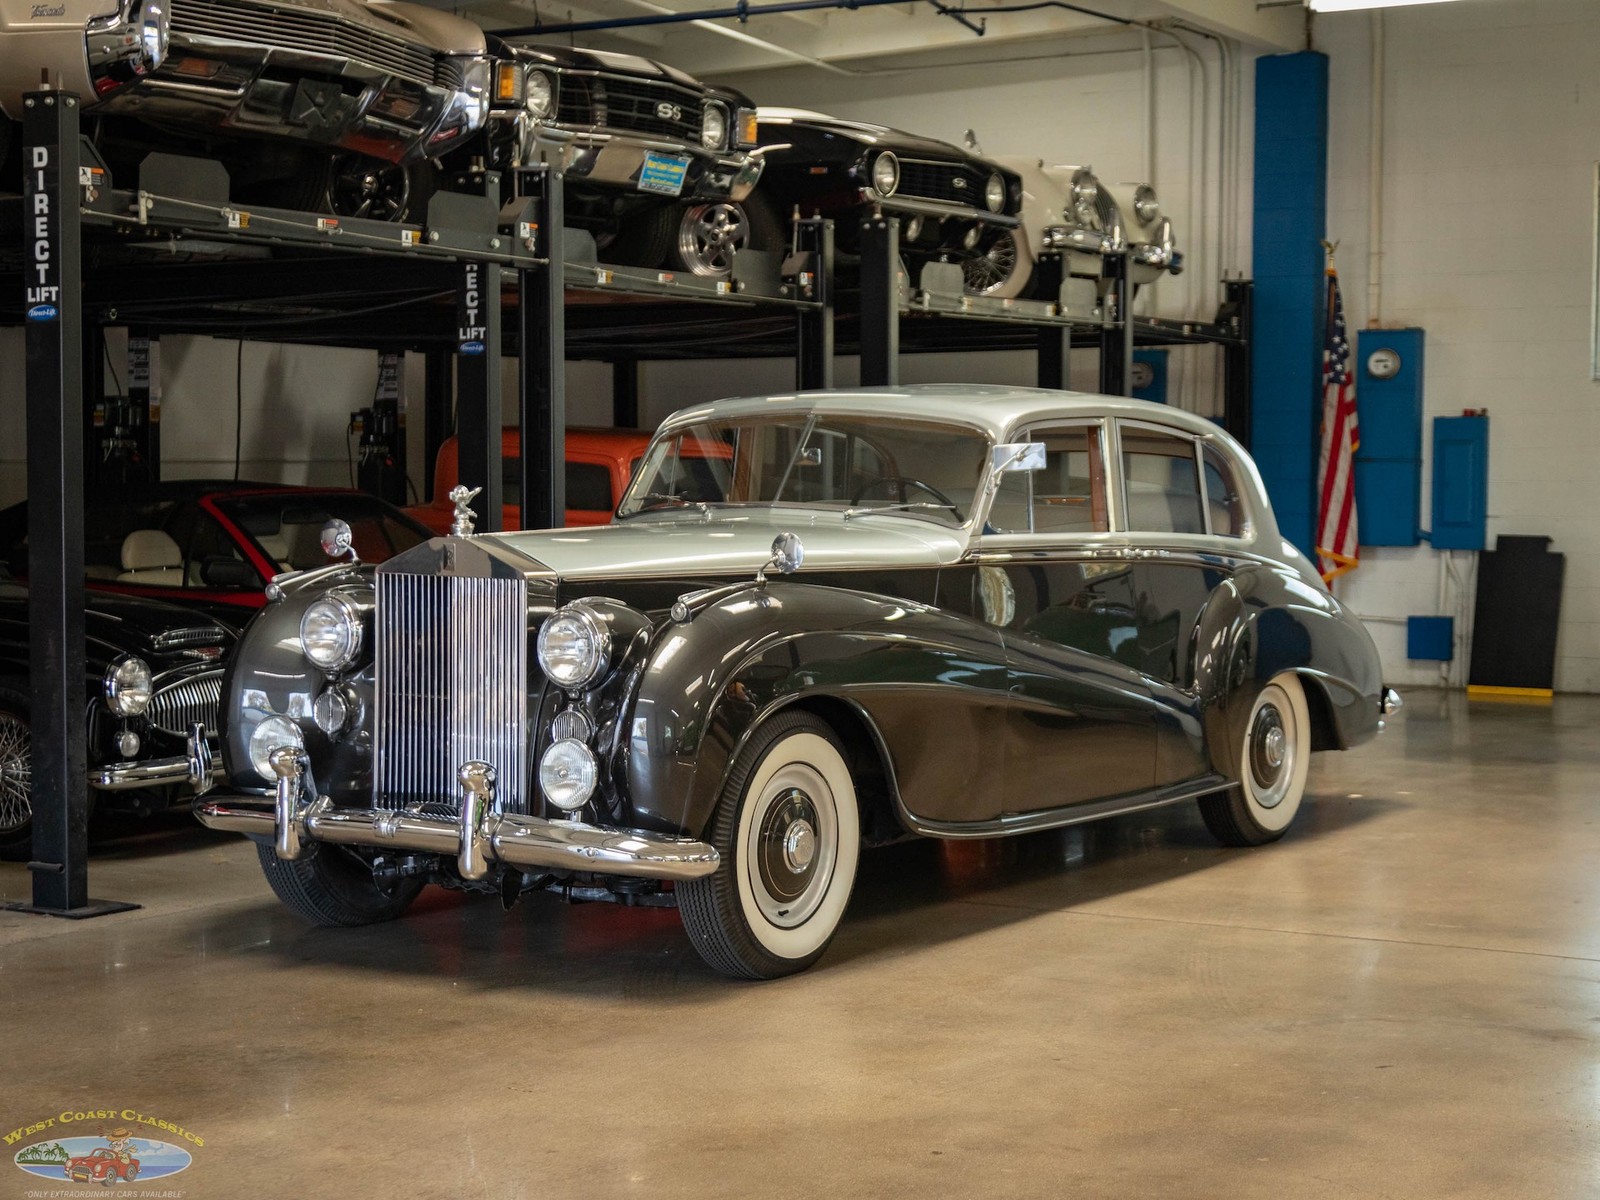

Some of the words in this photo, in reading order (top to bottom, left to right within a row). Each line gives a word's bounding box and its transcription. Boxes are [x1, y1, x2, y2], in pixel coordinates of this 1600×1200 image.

[657, 103, 681, 120] SS
[32, 146, 50, 284] DIRECT
[27, 286, 59, 303] LIFT
[459, 327, 486, 340] LIFT
